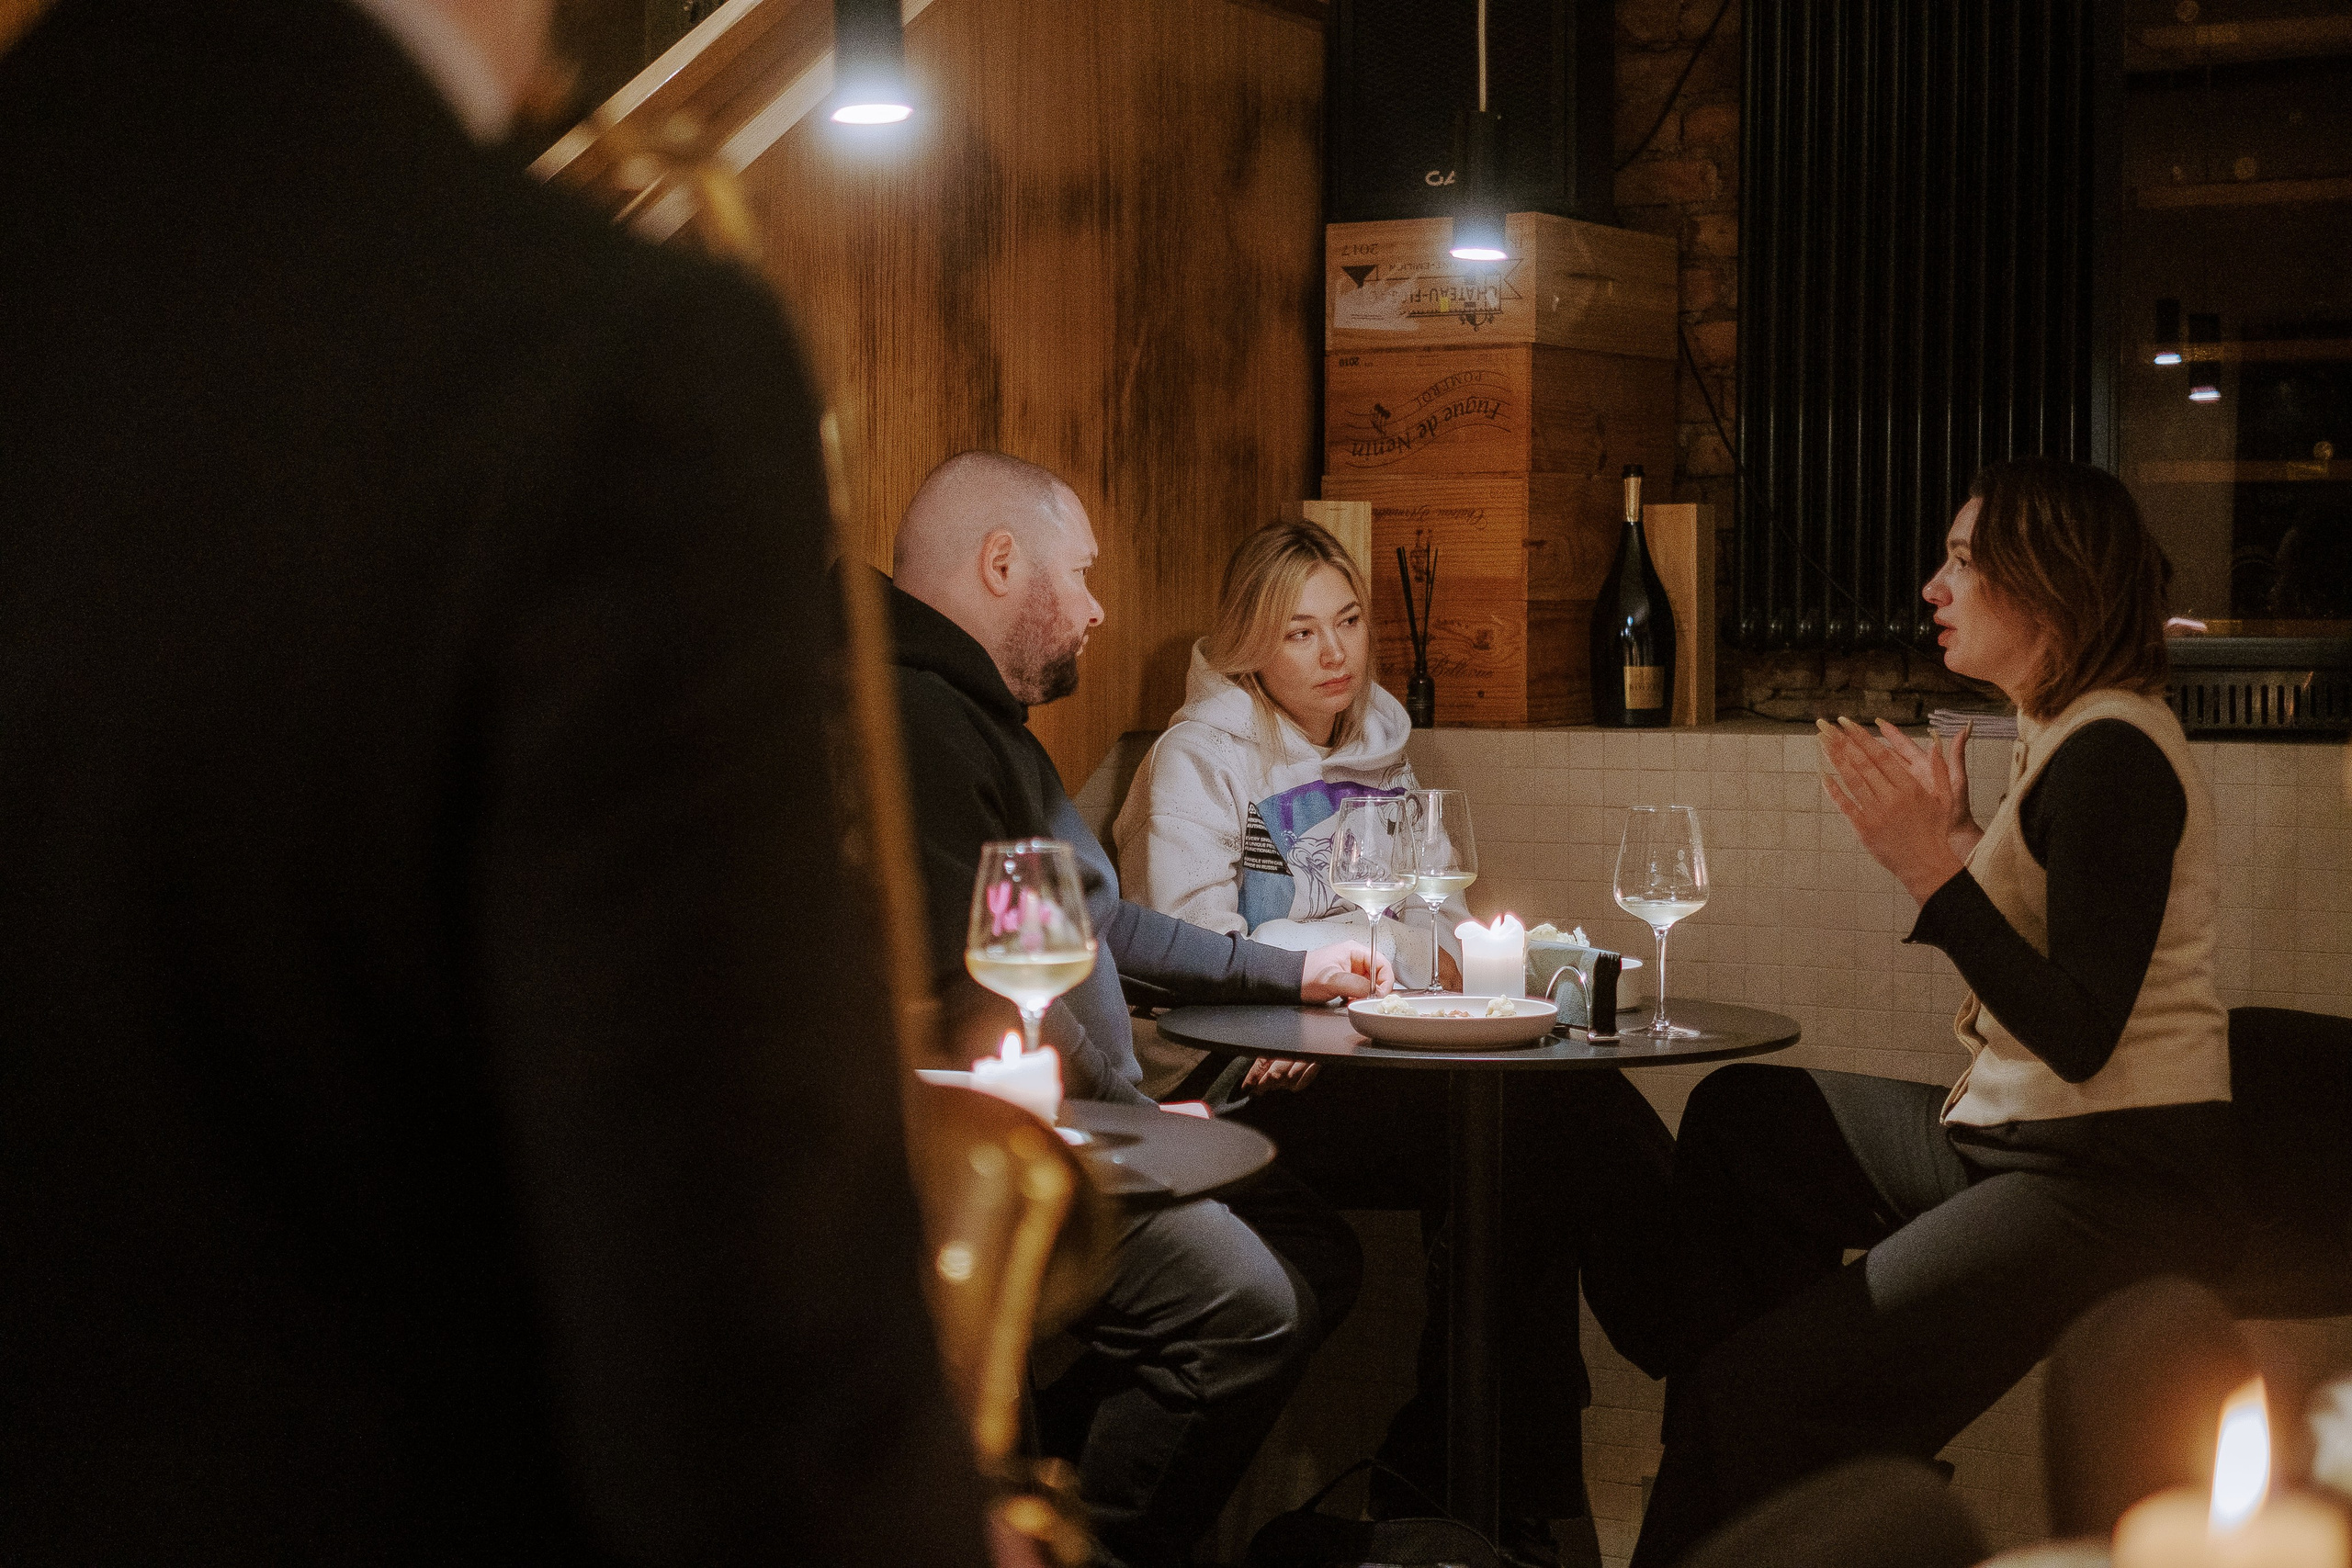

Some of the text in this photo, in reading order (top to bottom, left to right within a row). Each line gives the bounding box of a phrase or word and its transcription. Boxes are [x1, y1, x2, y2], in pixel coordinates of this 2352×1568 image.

[1340, 243, 1378, 257] 2017
[1413, 370, 1483, 409] POMEROL
[1351, 396, 1501, 461] Fugue de Nenin
